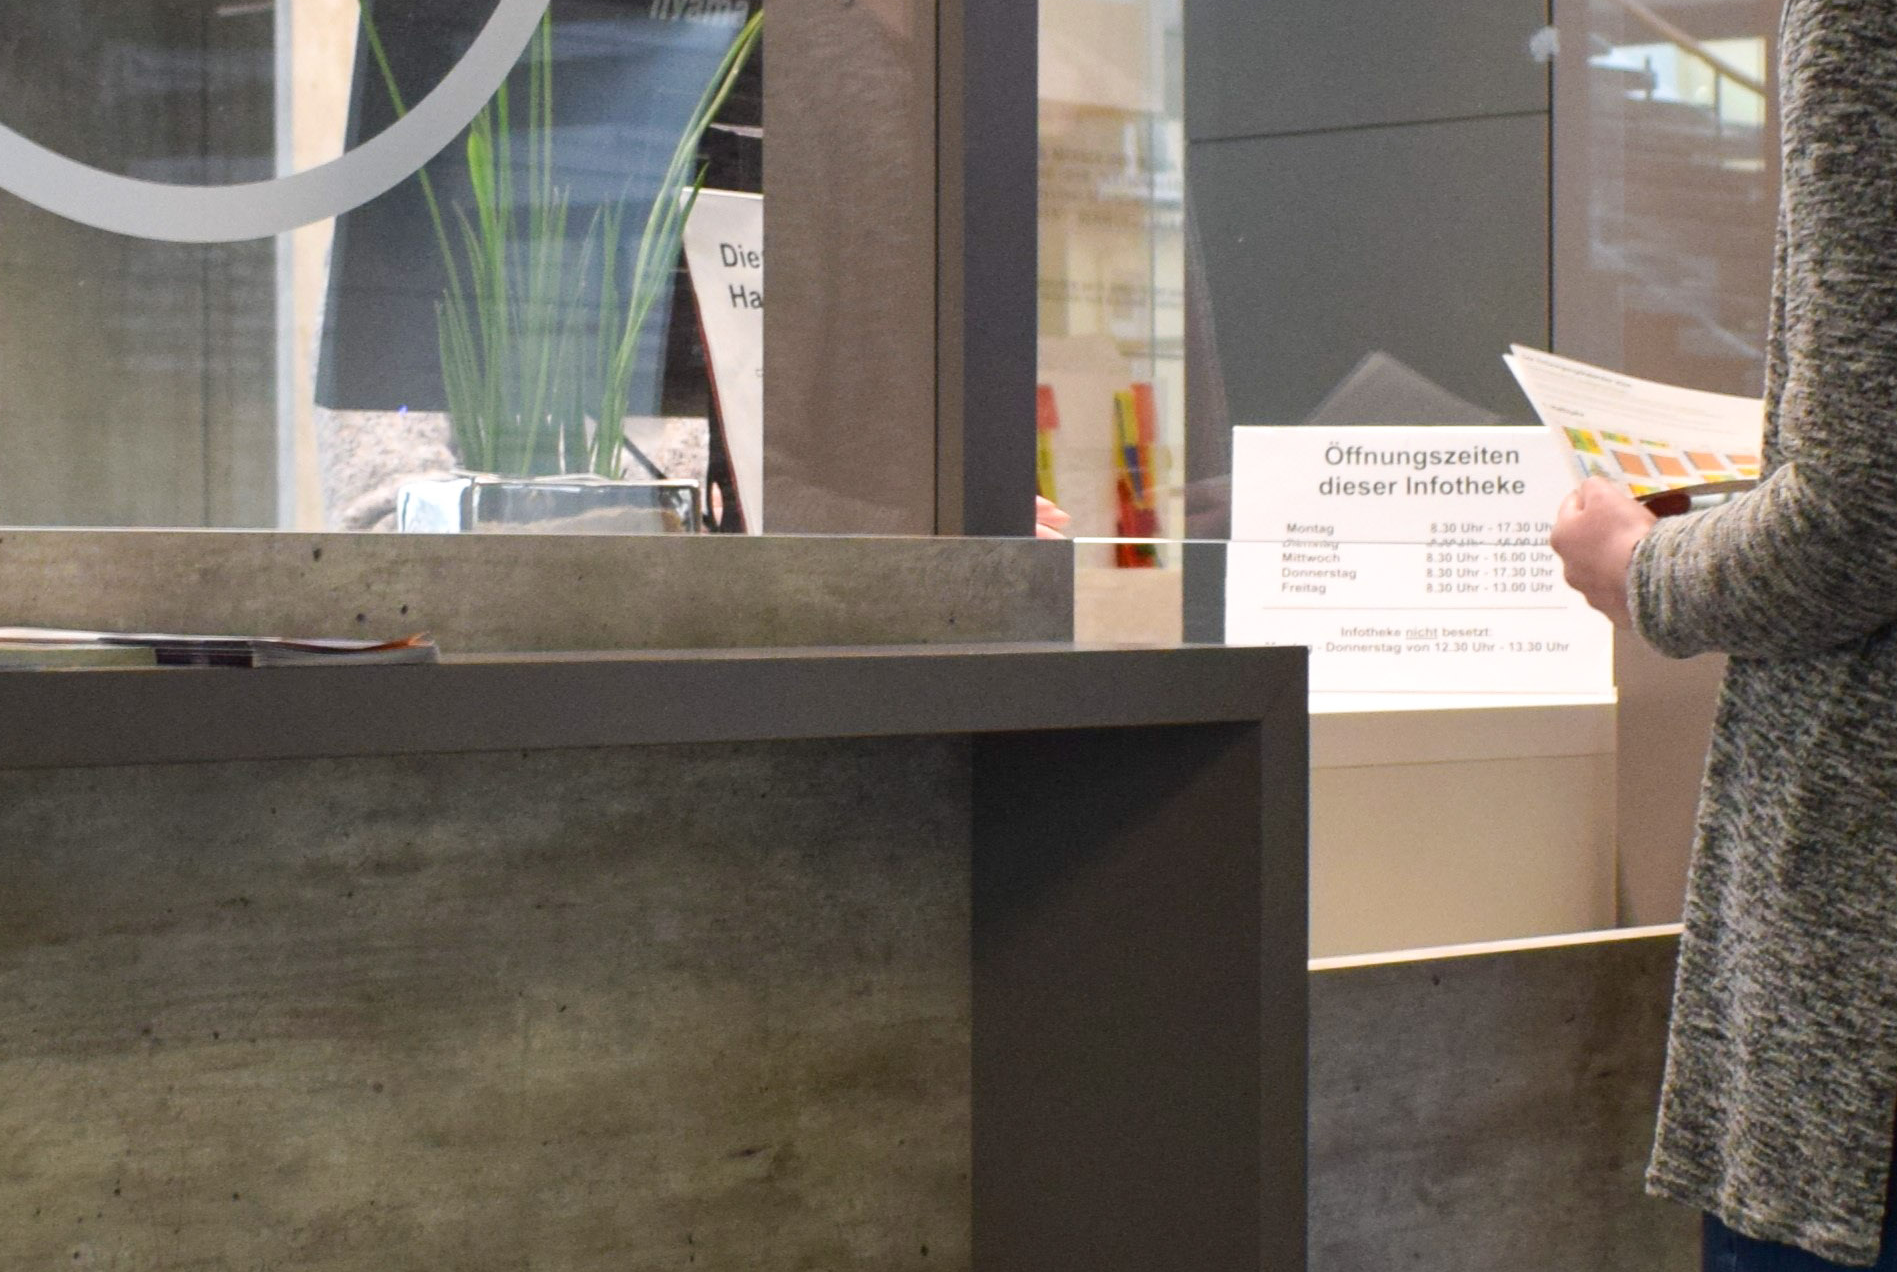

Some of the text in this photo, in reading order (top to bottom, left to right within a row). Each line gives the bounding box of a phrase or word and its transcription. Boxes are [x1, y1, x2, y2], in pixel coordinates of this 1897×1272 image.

[719, 242, 764, 269] Die
[728, 284, 764, 309] Ha
[1324, 441, 1520, 471] Öffnungszeiten
[1318, 475, 1526, 496] dieser Infotheke
[1286, 523, 1335, 536] Montag
[1430, 522, 1457, 534] 8.30
[1461, 522, 1483, 534] Uhr
[1497, 522, 1531, 534] 17.30
[1534, 522, 1553, 534] Uh
[1282, 553, 1340, 563] Mittwoch
[1426, 552, 1452, 563] 8.30
[1456, 552, 1480, 563] Uhr
[1493, 552, 1526, 563] 16.00
[1530, 552, 1553, 563] Uhr
[1281, 567, 1357, 580] Donnerstag
[1426, 567, 1452, 578] 8.30
[1456, 567, 1480, 578] Uhr
[1493, 567, 1526, 578] 17.30
[1530, 567, 1553, 578] Uhr
[1281, 582, 1327, 595] Freitag
[1426, 582, 1452, 593] 8.30
[1456, 582, 1480, 593] Uhr
[1493, 582, 1526, 593] 13.00
[1530, 582, 1553, 593] Uhr
[1341, 626, 1402, 638] Infotheke
[1405, 626, 1438, 640] nicht
[1325, 641, 1402, 655] Donnerstag
[1406, 643, 1430, 653] von
[1434, 641, 1468, 653] 12.30
[1471, 641, 1495, 652] Uhr
[1545, 641, 1570, 652] Uhr
